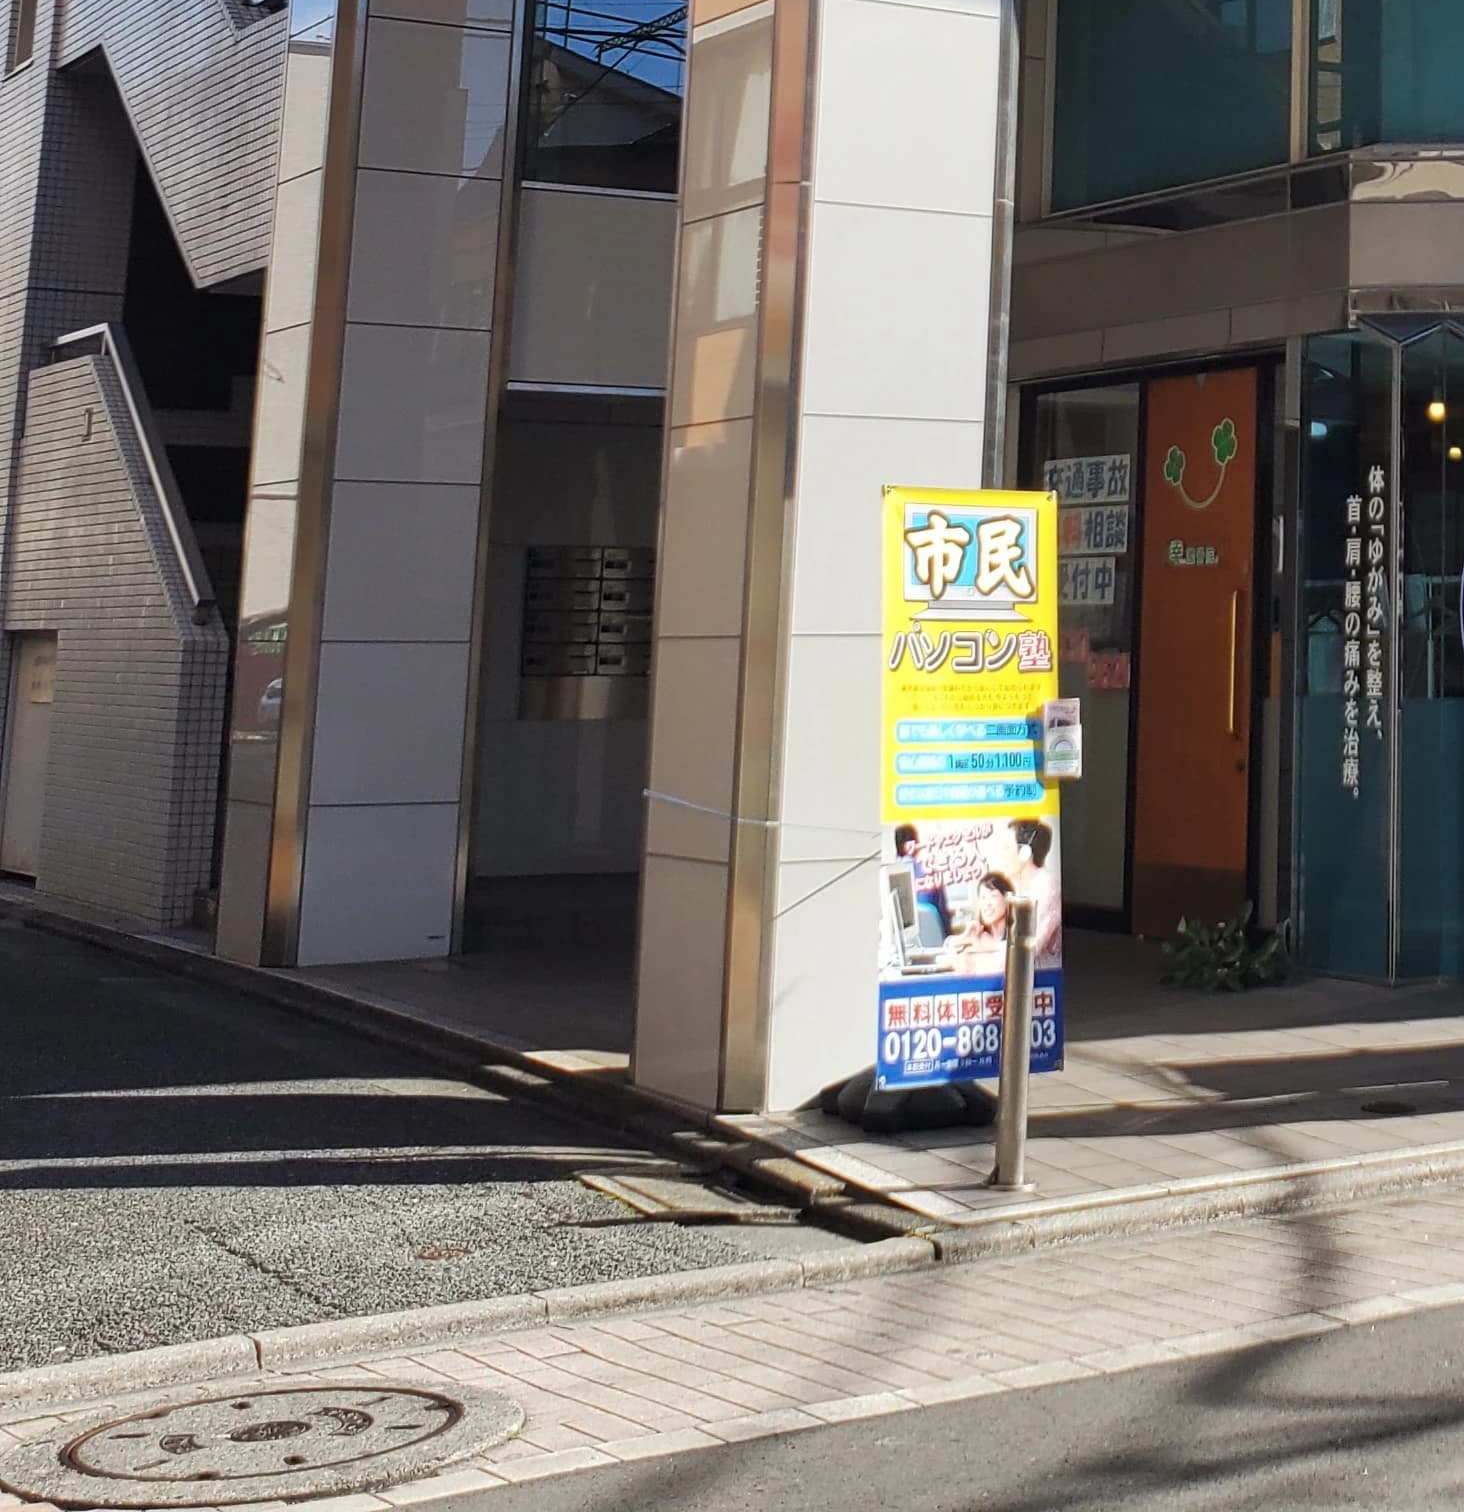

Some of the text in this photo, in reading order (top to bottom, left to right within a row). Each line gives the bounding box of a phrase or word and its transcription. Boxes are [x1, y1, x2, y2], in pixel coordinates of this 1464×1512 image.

[903, 509, 1036, 601] 市民
[887, 620, 1053, 674] パソコン塾
[887, 991, 1054, 1028] 無料体験受中
[883, 1018, 1057, 1065] 0120-86803
